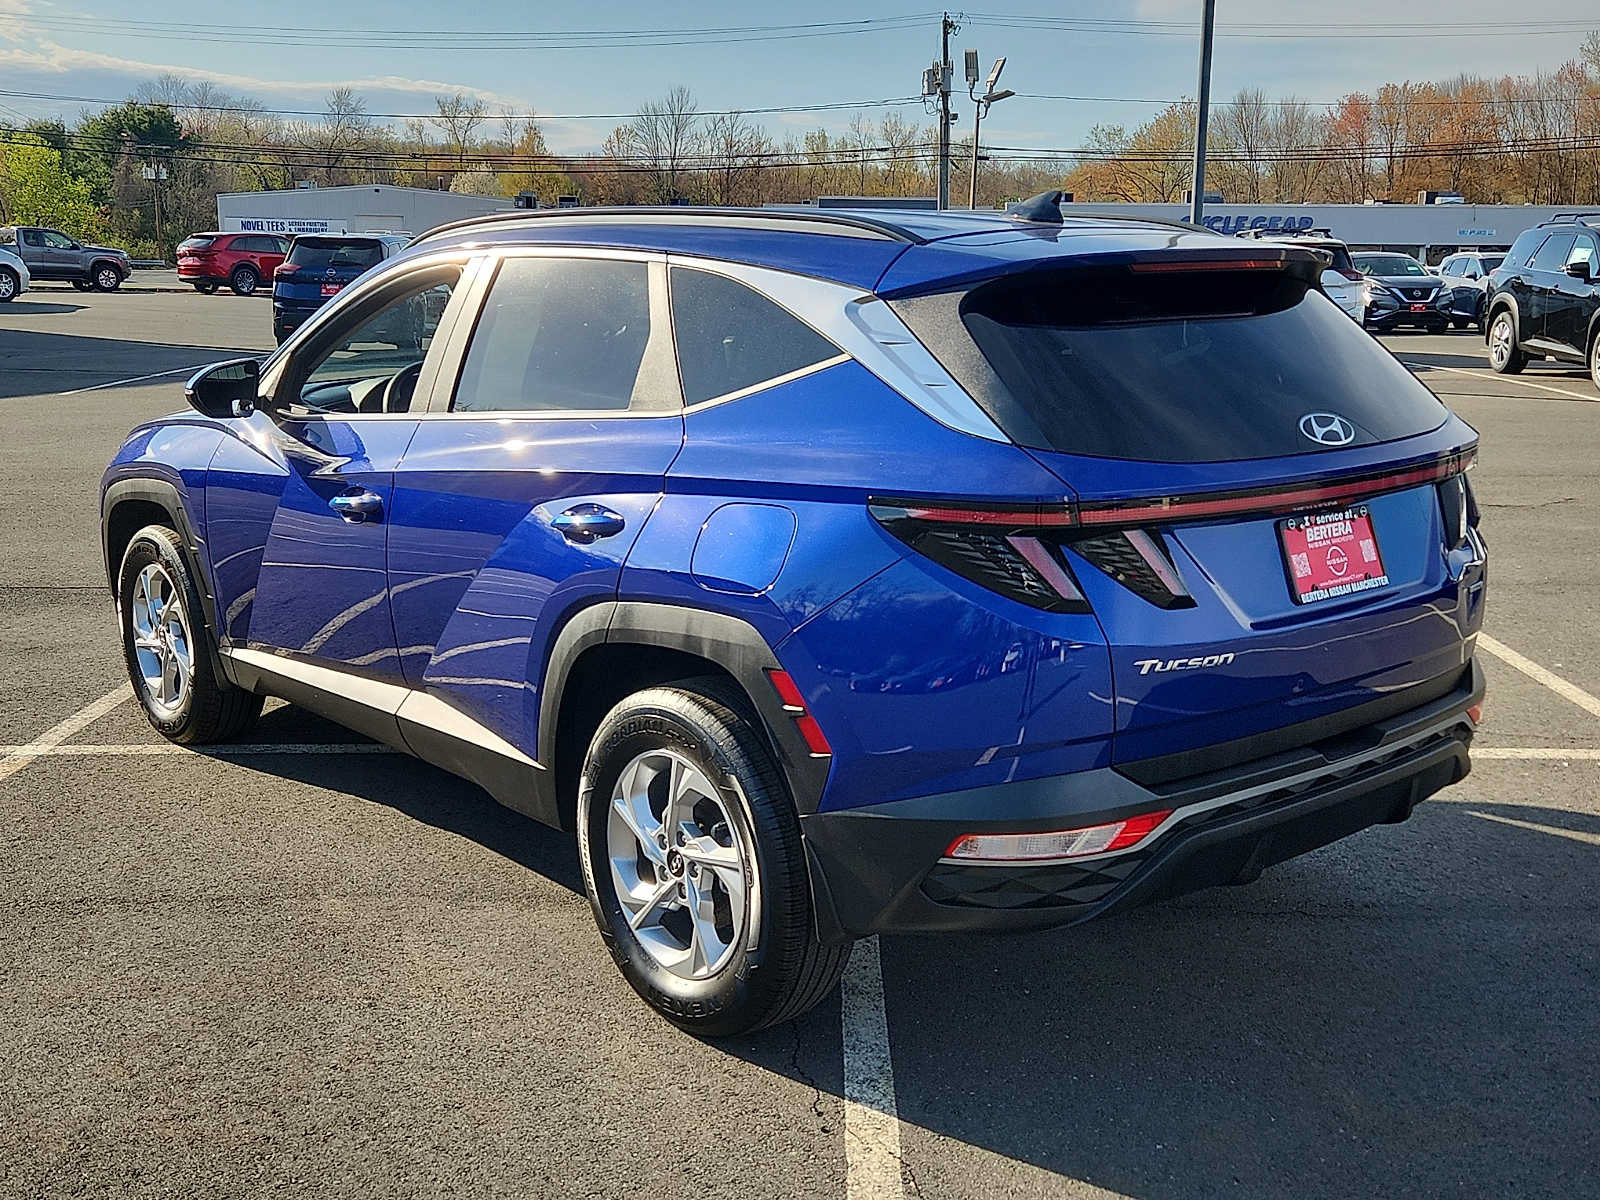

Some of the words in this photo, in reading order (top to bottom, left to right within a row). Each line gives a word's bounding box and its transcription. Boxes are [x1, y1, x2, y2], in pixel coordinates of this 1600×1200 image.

[240, 220, 264, 231] NOVEL
[266, 221, 286, 232] TEES
[1316, 511, 1344, 525] service
[1306, 521, 1353, 542] BERTERA
[1307, 539, 1331, 550] NISSAN
[1326, 556, 1349, 566] NISSAN
[1300, 589, 1330, 604] BERTERA
[1329, 583, 1352, 598] NISSAN
[1351, 575, 1389, 593] MANCHESTER
